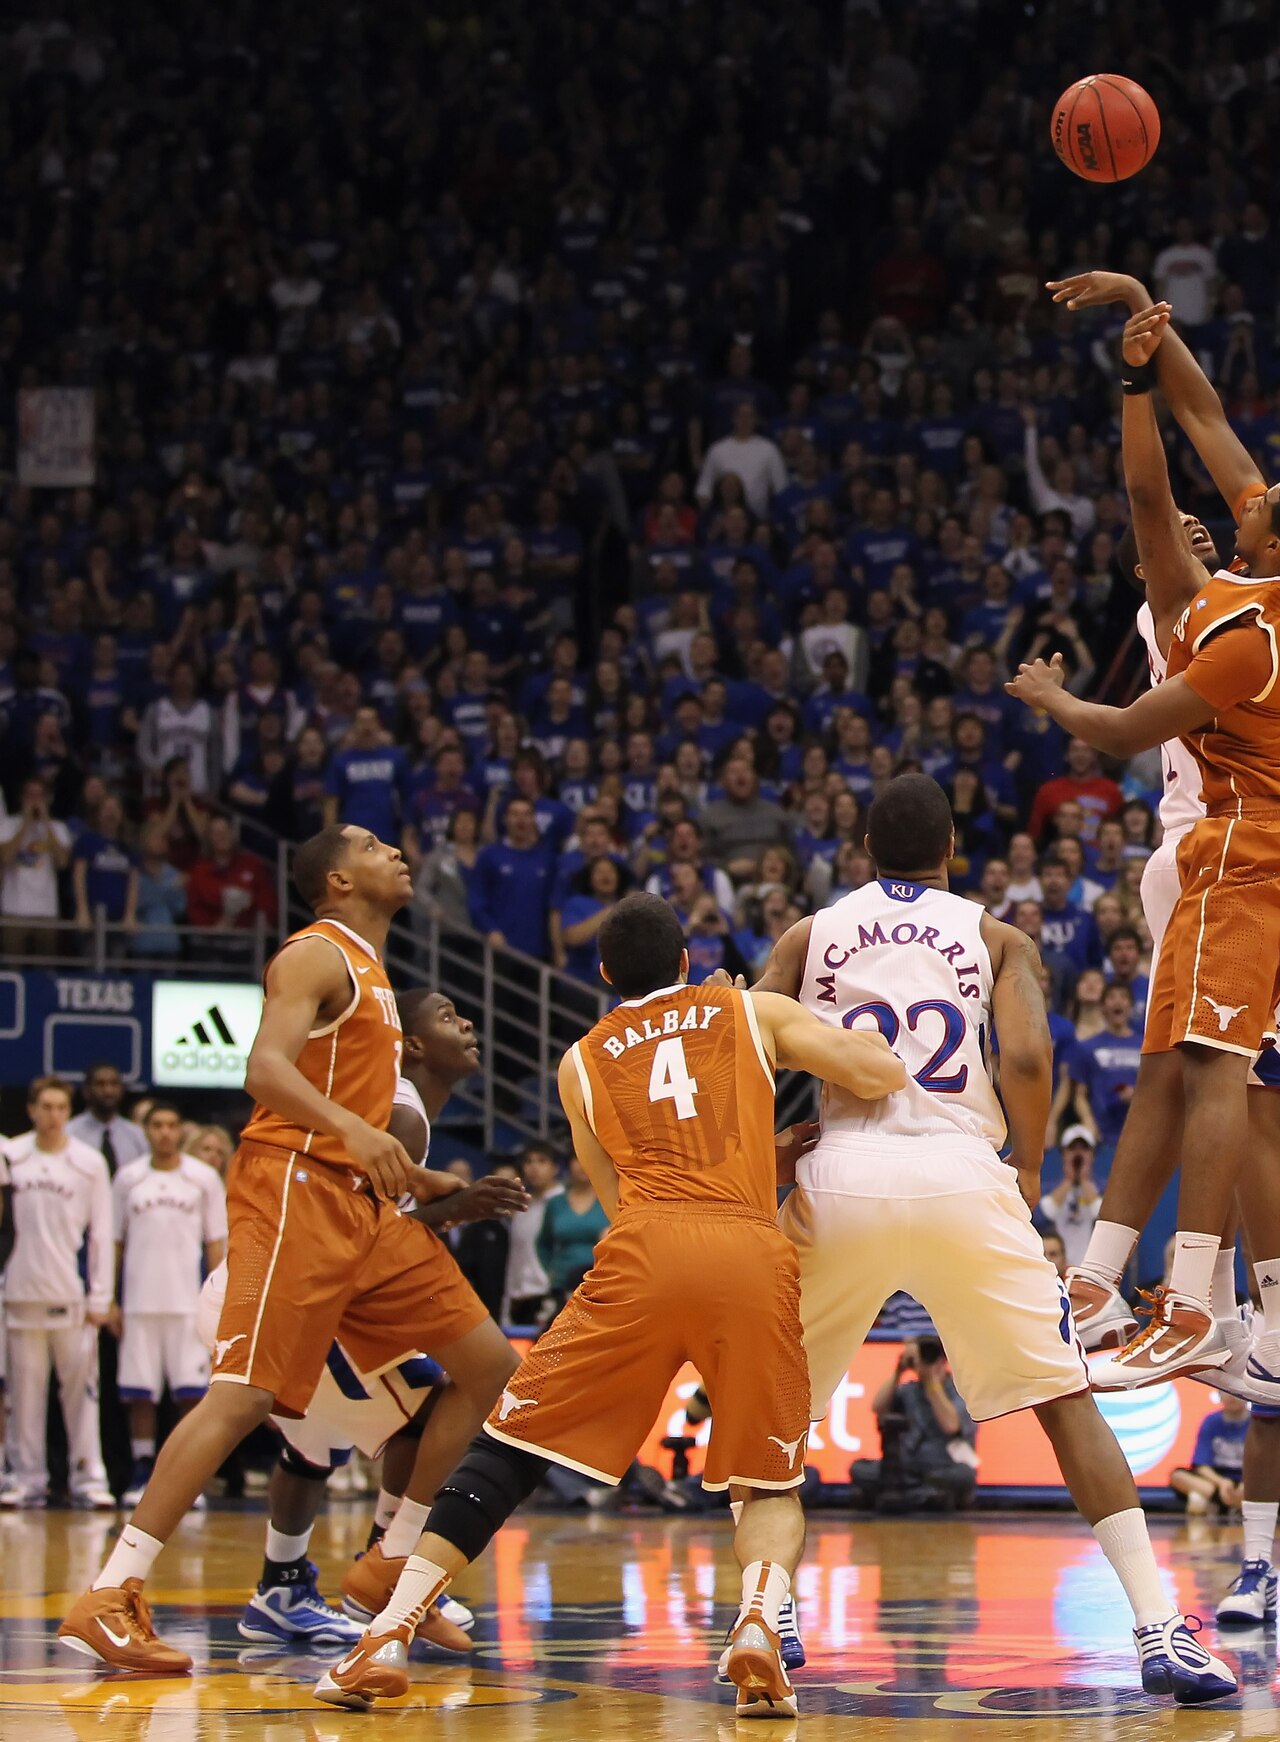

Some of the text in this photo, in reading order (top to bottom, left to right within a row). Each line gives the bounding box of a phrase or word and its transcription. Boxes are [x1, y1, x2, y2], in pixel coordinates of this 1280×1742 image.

[1076, 123, 1101, 171] NCAA
[890, 884, 915, 899] KU
[56, 979, 134, 1010] TEXAS
[602, 1005, 722, 1060] BALBAY
[648, 1035, 698, 1121] 4
